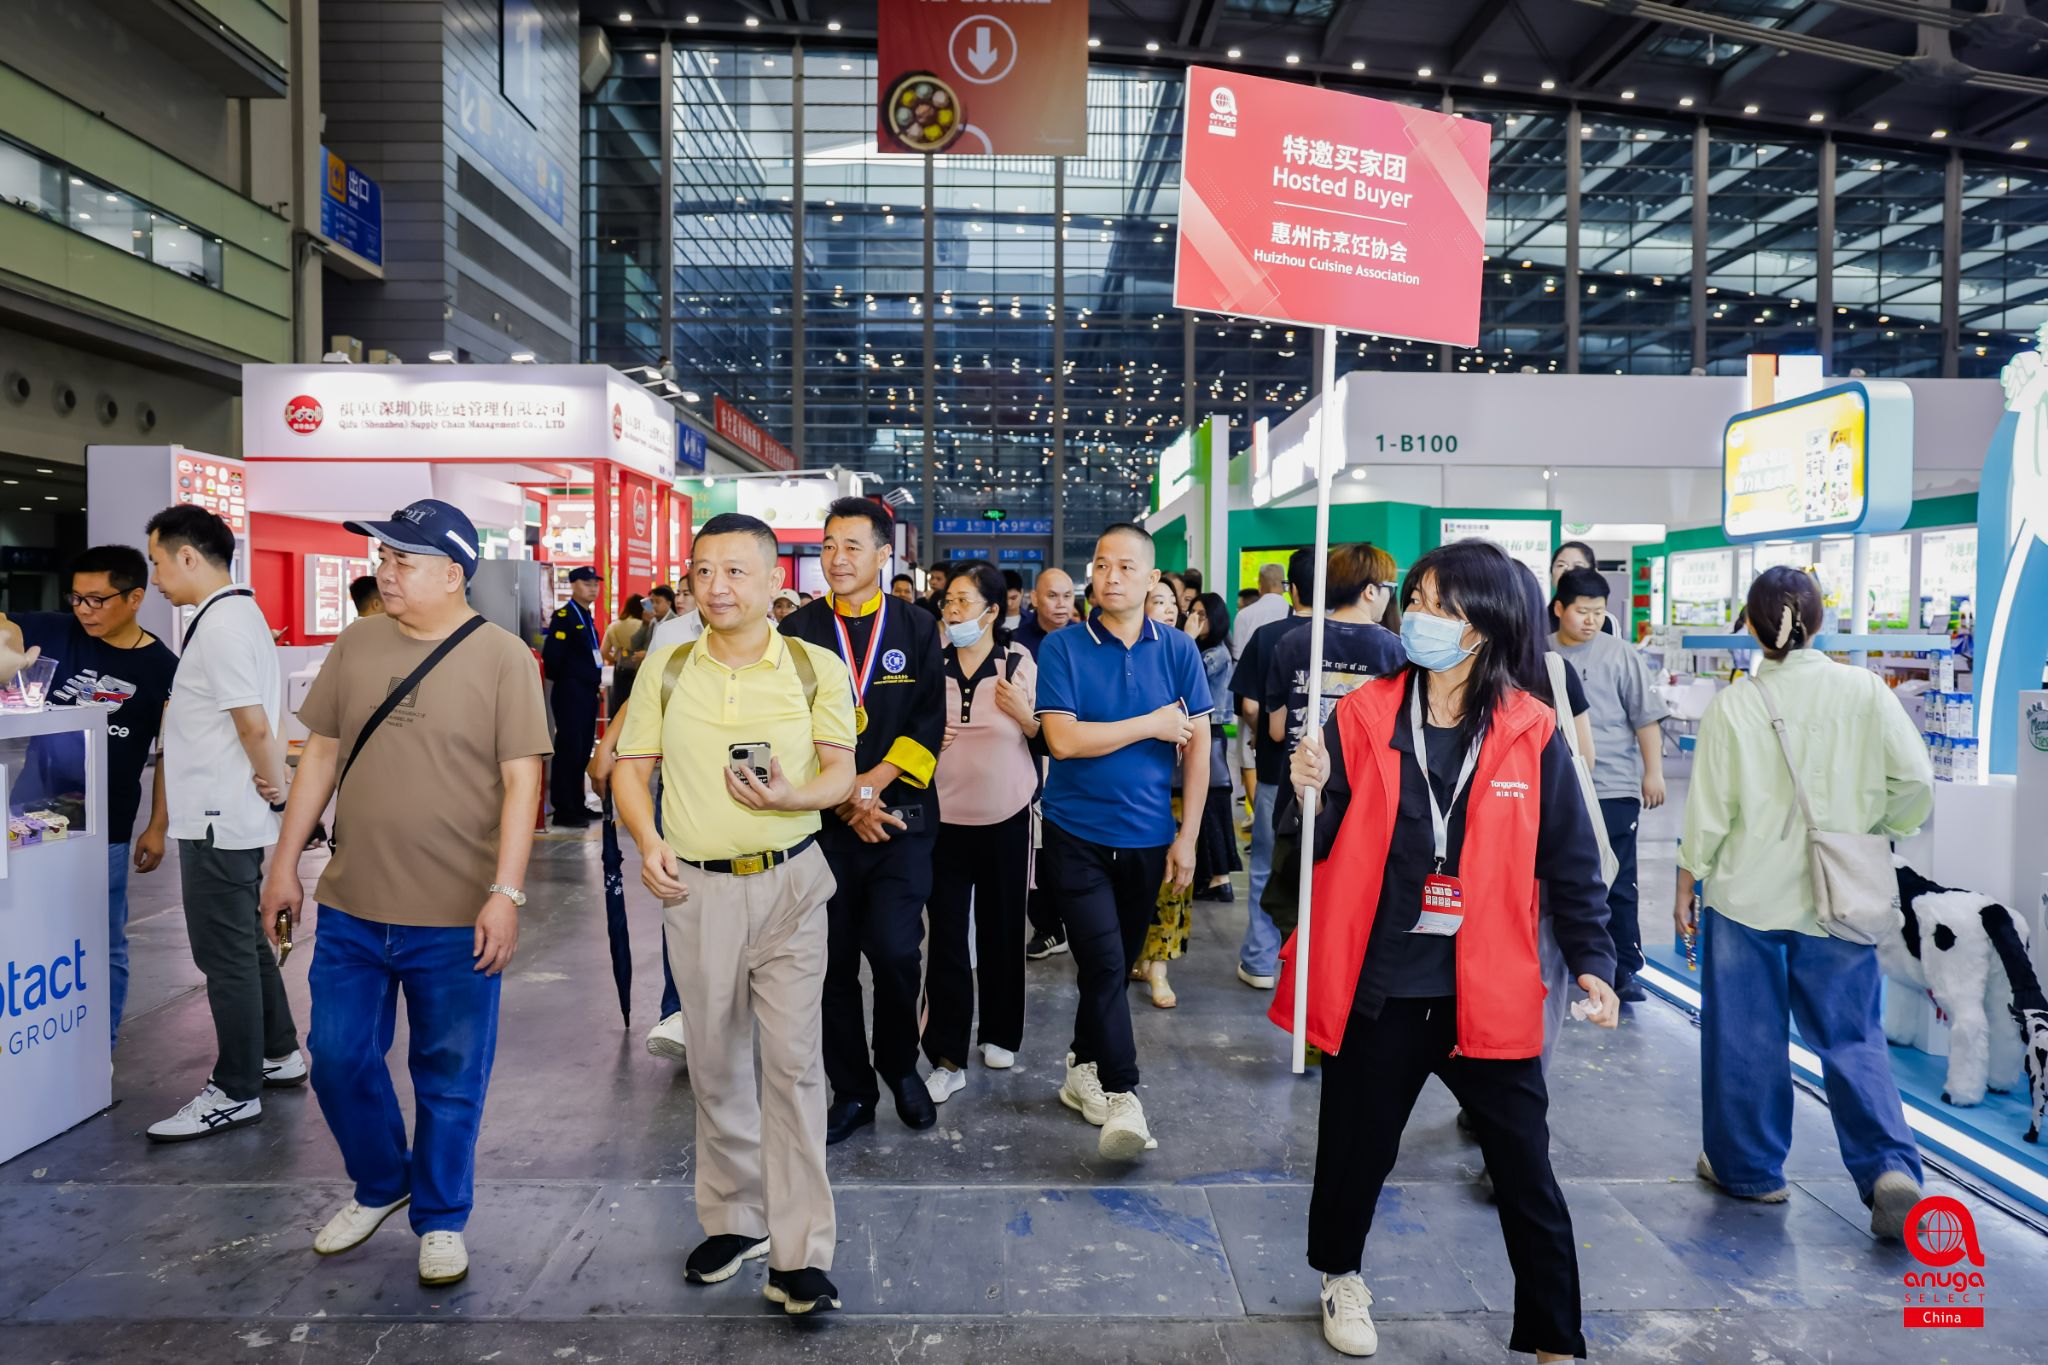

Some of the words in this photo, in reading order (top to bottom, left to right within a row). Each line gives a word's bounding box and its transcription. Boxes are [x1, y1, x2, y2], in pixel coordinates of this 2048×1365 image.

[1209, 112, 1238, 123] anuga
[1282, 134, 1408, 184] 特邀买家团
[348, 170, 370, 203] 出口
[1272, 166, 1347, 198] Hosted
[1353, 180, 1413, 209] Buyer
[1270, 221, 1408, 264] 惠州市烹饪协会
[1253, 248, 1306, 268] Huizhou
[1309, 257, 1353, 275] Cuisine
[1355, 264, 1421, 286] Association
[411, 420, 439, 431] Supply
[442, 420, 465, 430] Chain
[468, 420, 521, 431] Management
[1376, 433, 1458, 453] 1-B100
[107, 725, 130, 738] ce
[9, 1004, 87, 1055] GROUP
